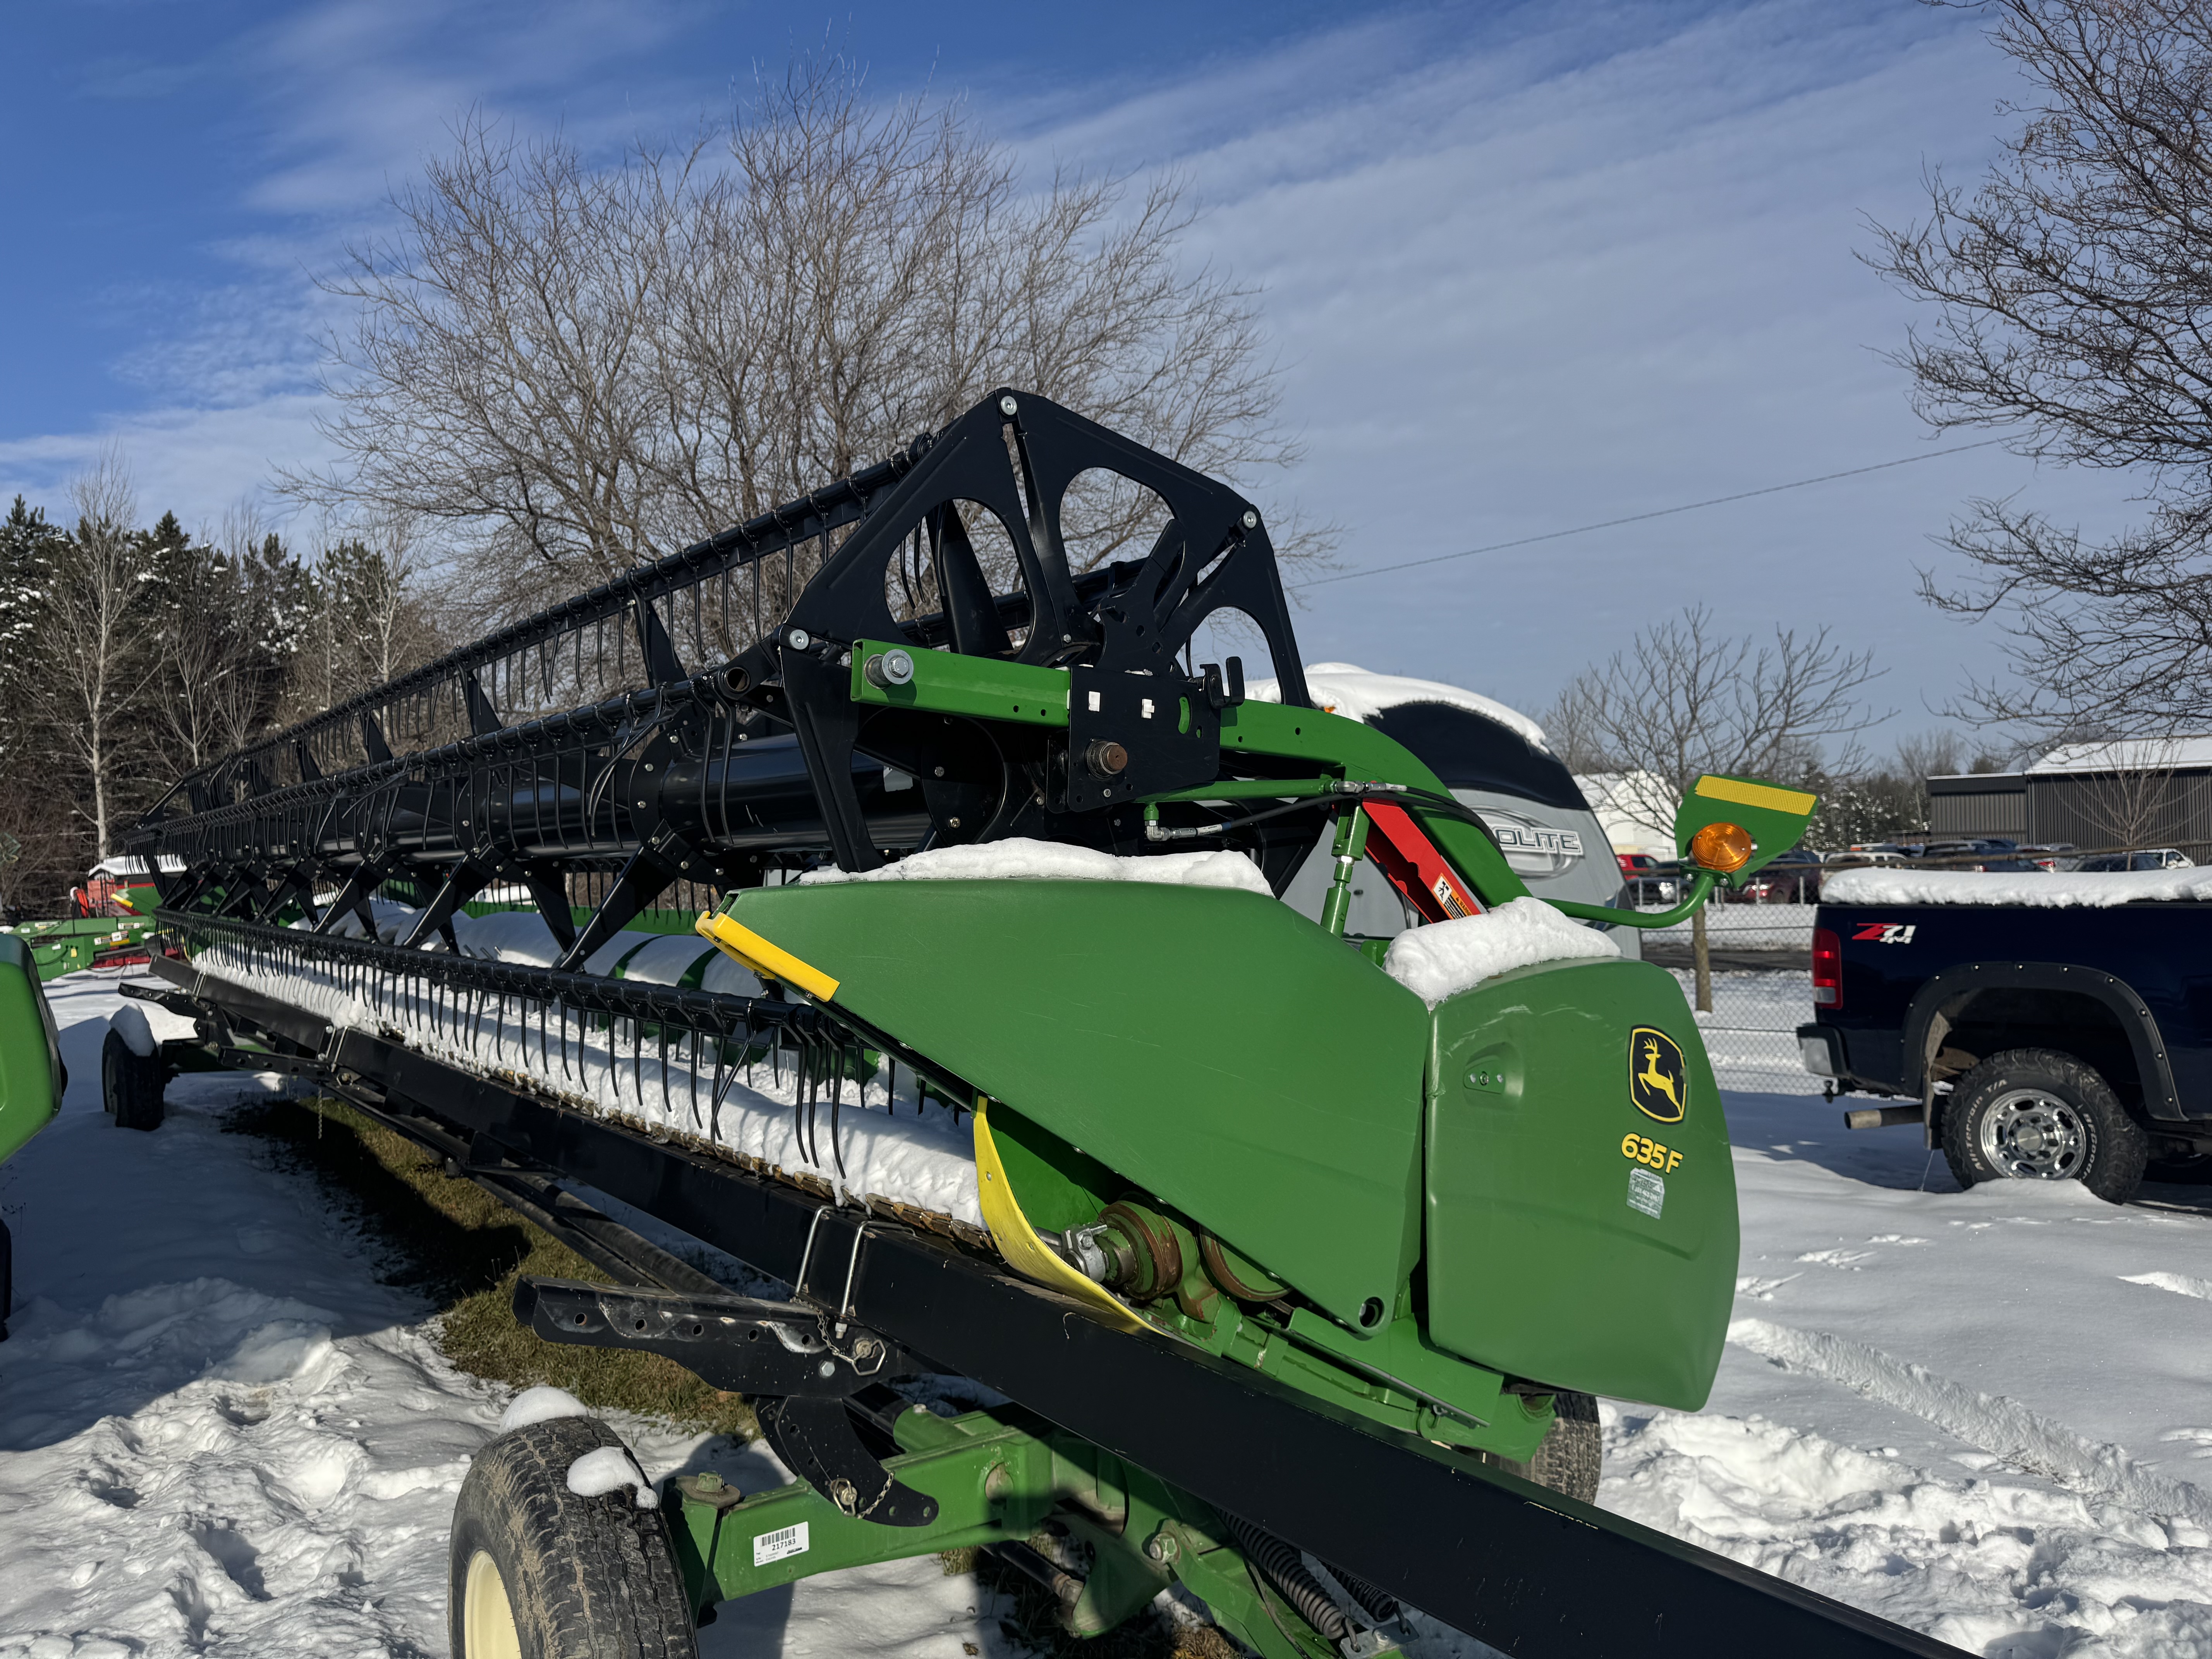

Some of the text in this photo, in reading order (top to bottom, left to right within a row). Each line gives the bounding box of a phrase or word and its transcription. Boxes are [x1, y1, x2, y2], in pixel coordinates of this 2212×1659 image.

[1494, 827, 1582, 853] OLITE
[1852, 923, 1917, 940] Z71
[1985, 1079, 2008, 1093] T/A
[1621, 1132, 1684, 1174] 635F
[772, 1538, 796, 1551] 217183
